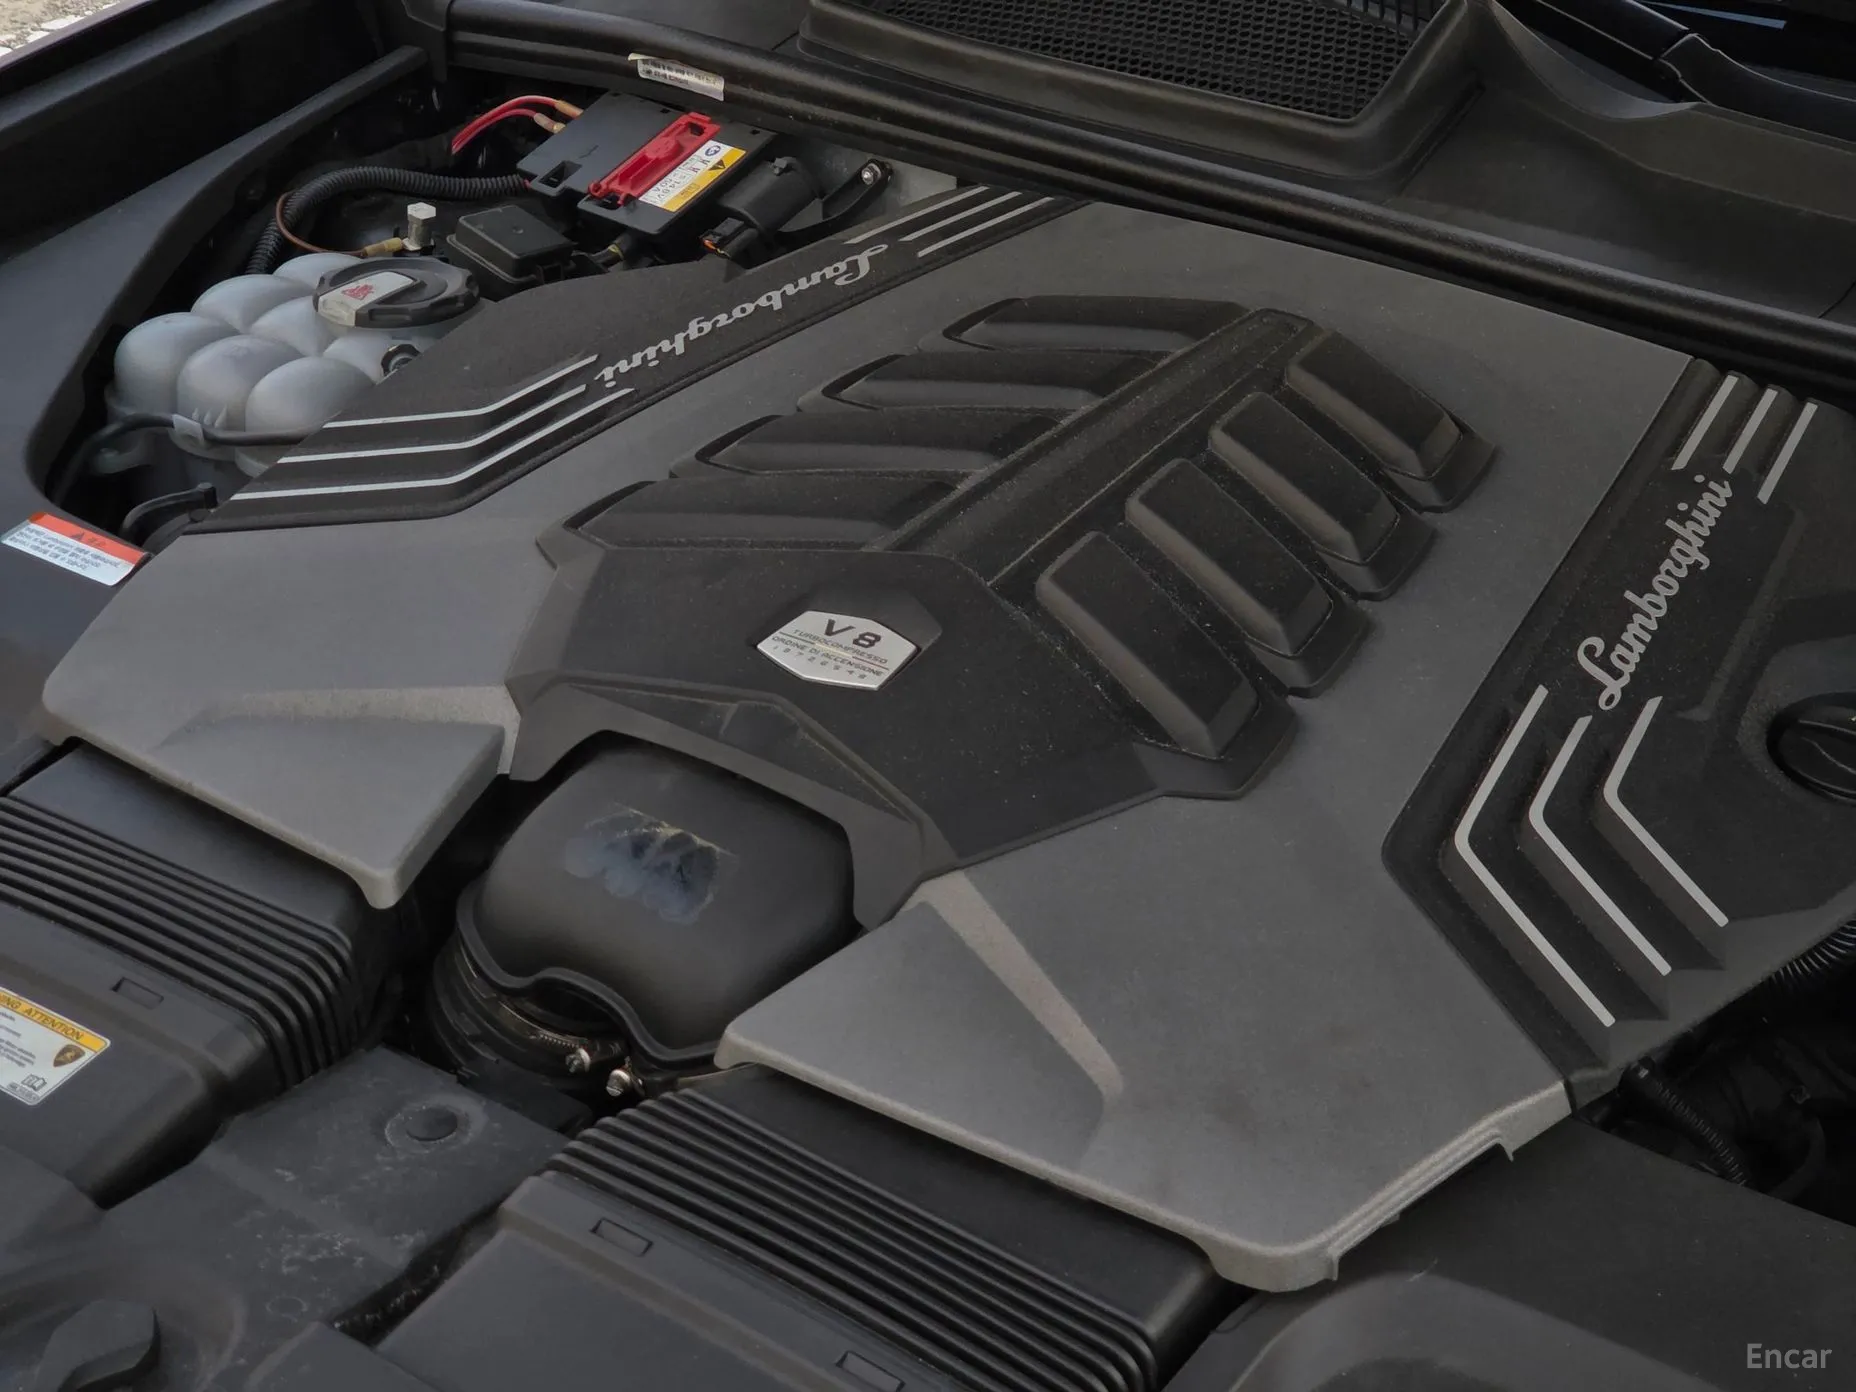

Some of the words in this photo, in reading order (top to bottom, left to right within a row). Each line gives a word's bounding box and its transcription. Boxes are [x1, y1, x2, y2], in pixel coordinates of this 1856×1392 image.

[595, 244, 888, 388] Lamborghini
[1577, 474, 1733, 711] Lamborghini
[771, 635, 808, 651] ORDINE
[819, 650, 884, 677] ACCENSIONE
[793, 629, 888, 664] TURBOCOMPRESSO
[24, 1007, 85, 1040] ATTENTION
